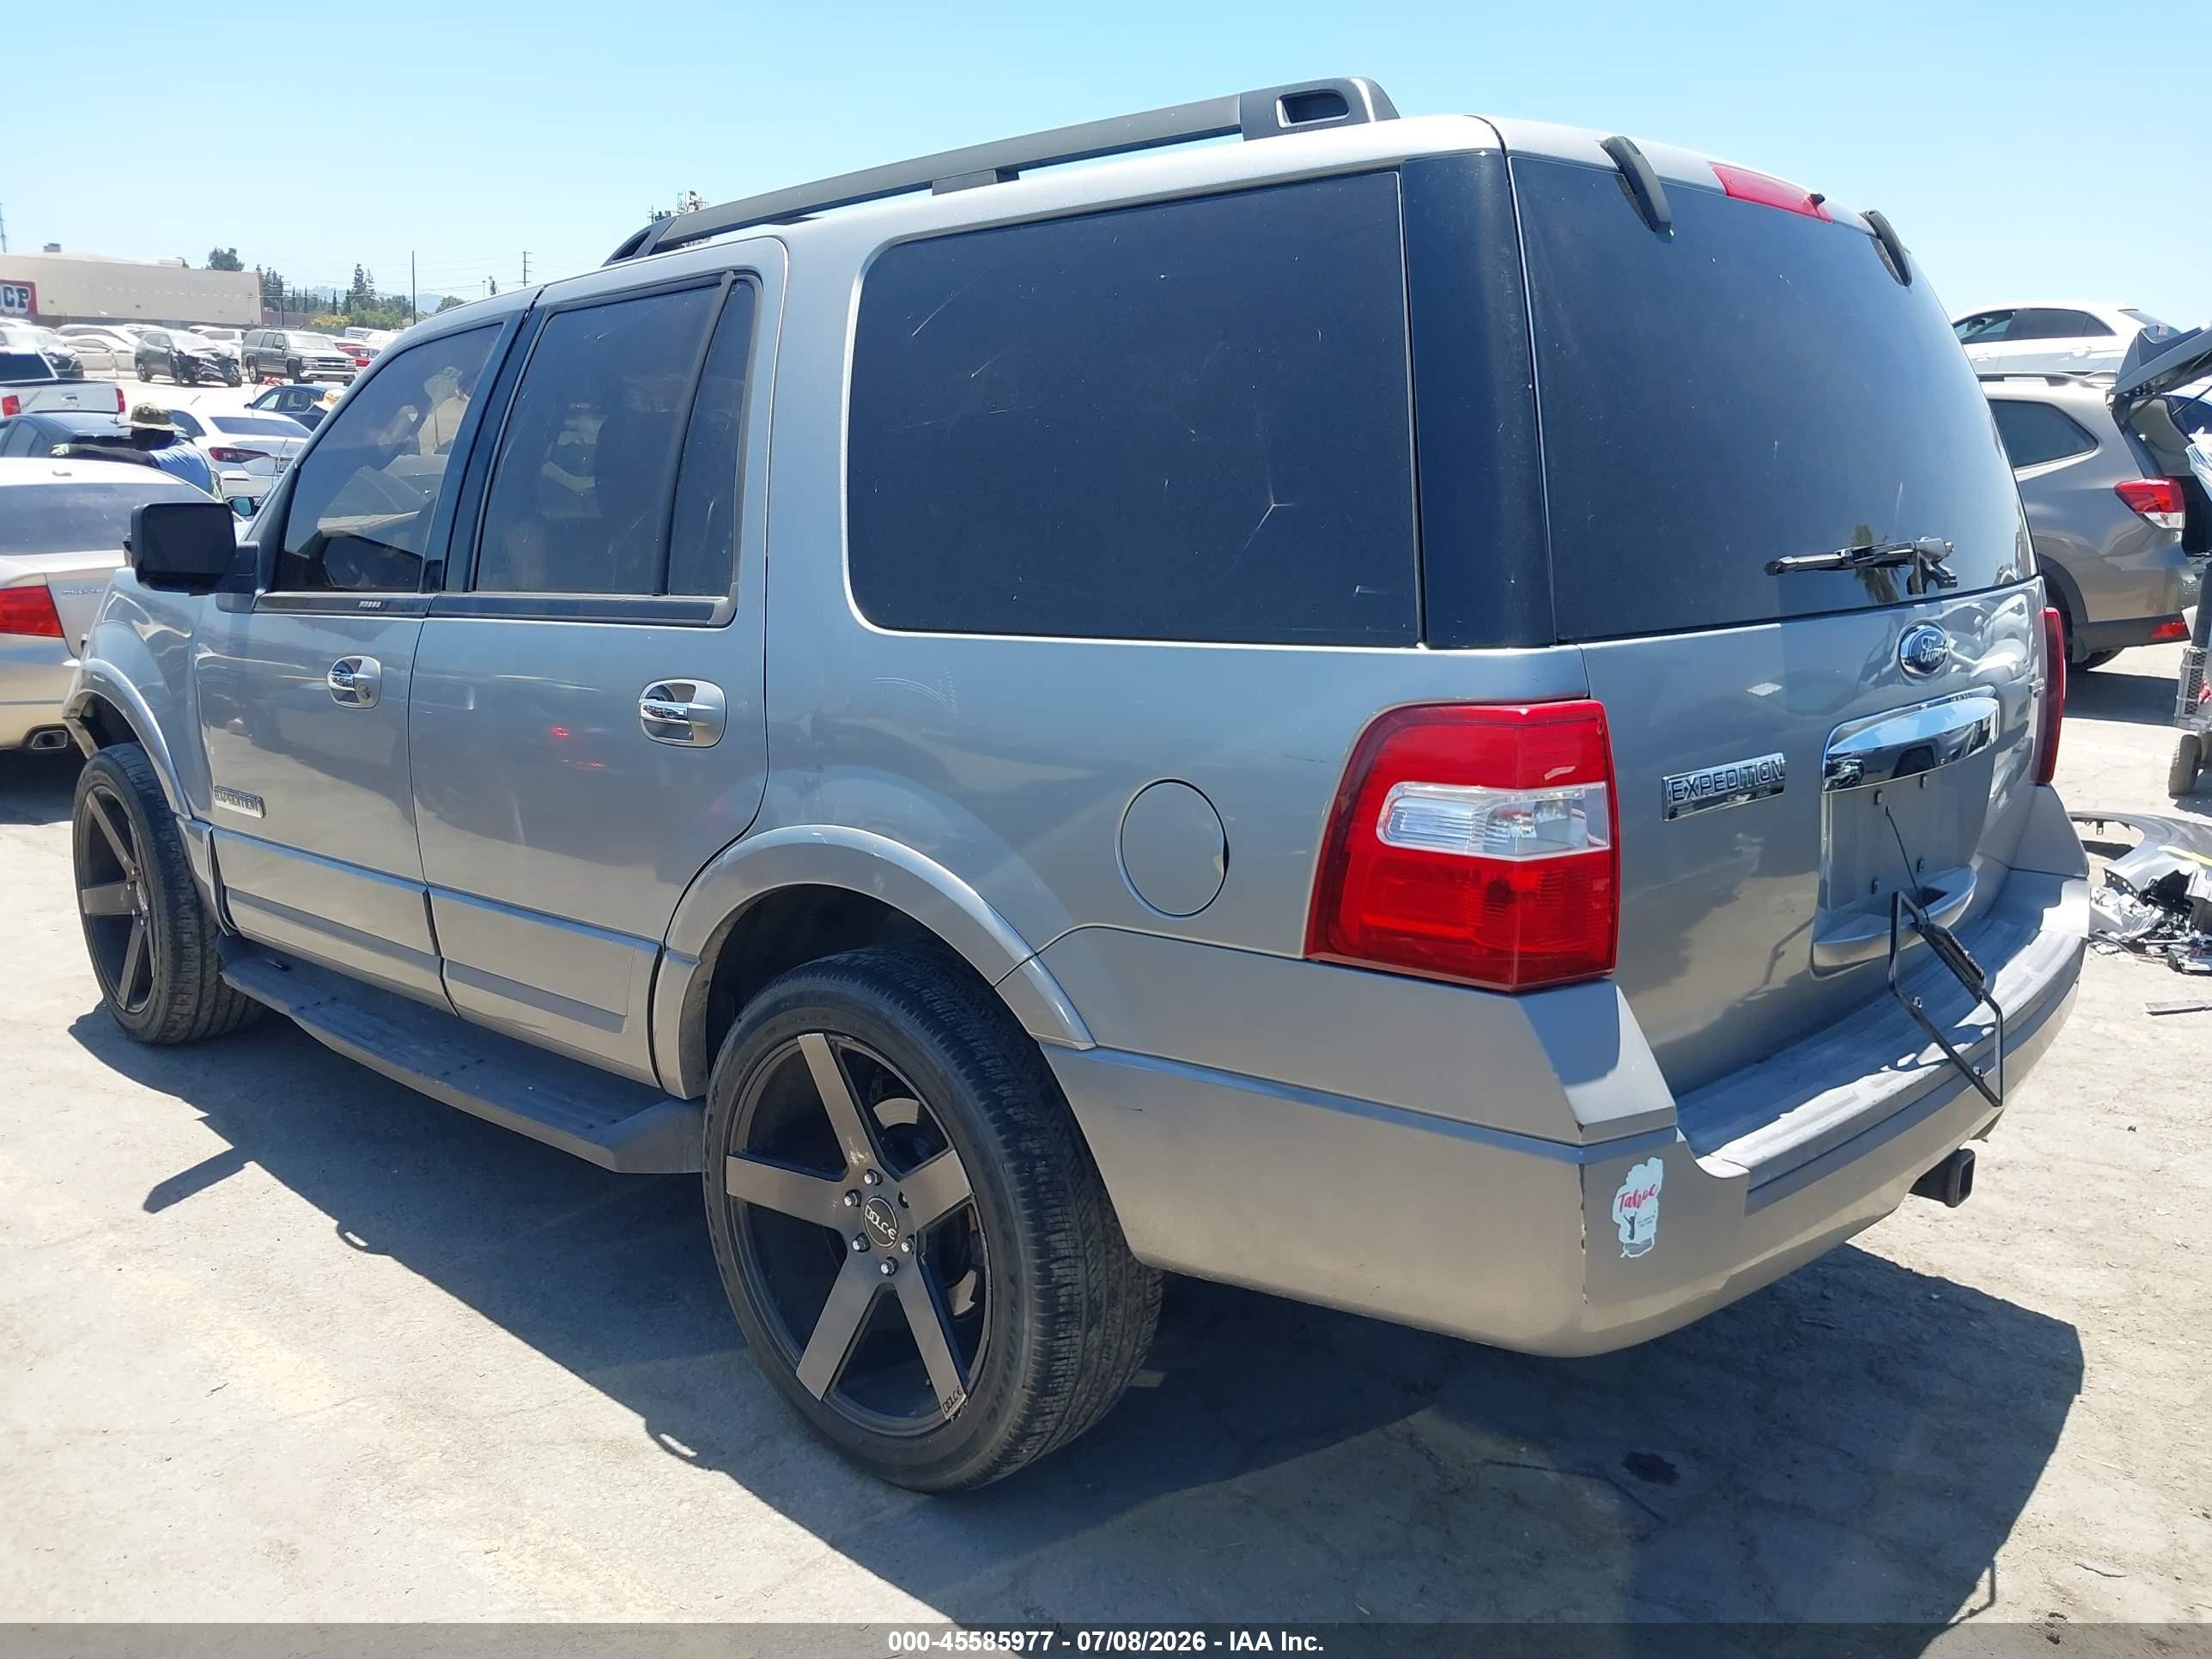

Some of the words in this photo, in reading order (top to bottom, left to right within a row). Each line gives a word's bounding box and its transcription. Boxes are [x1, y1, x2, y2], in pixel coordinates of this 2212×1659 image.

[0, 284, 31, 313] CP
[1919, 635, 1945, 663] Ford
[1670, 757, 1784, 802] EXPEDITION
[864, 1204, 897, 1241] DOLCE
